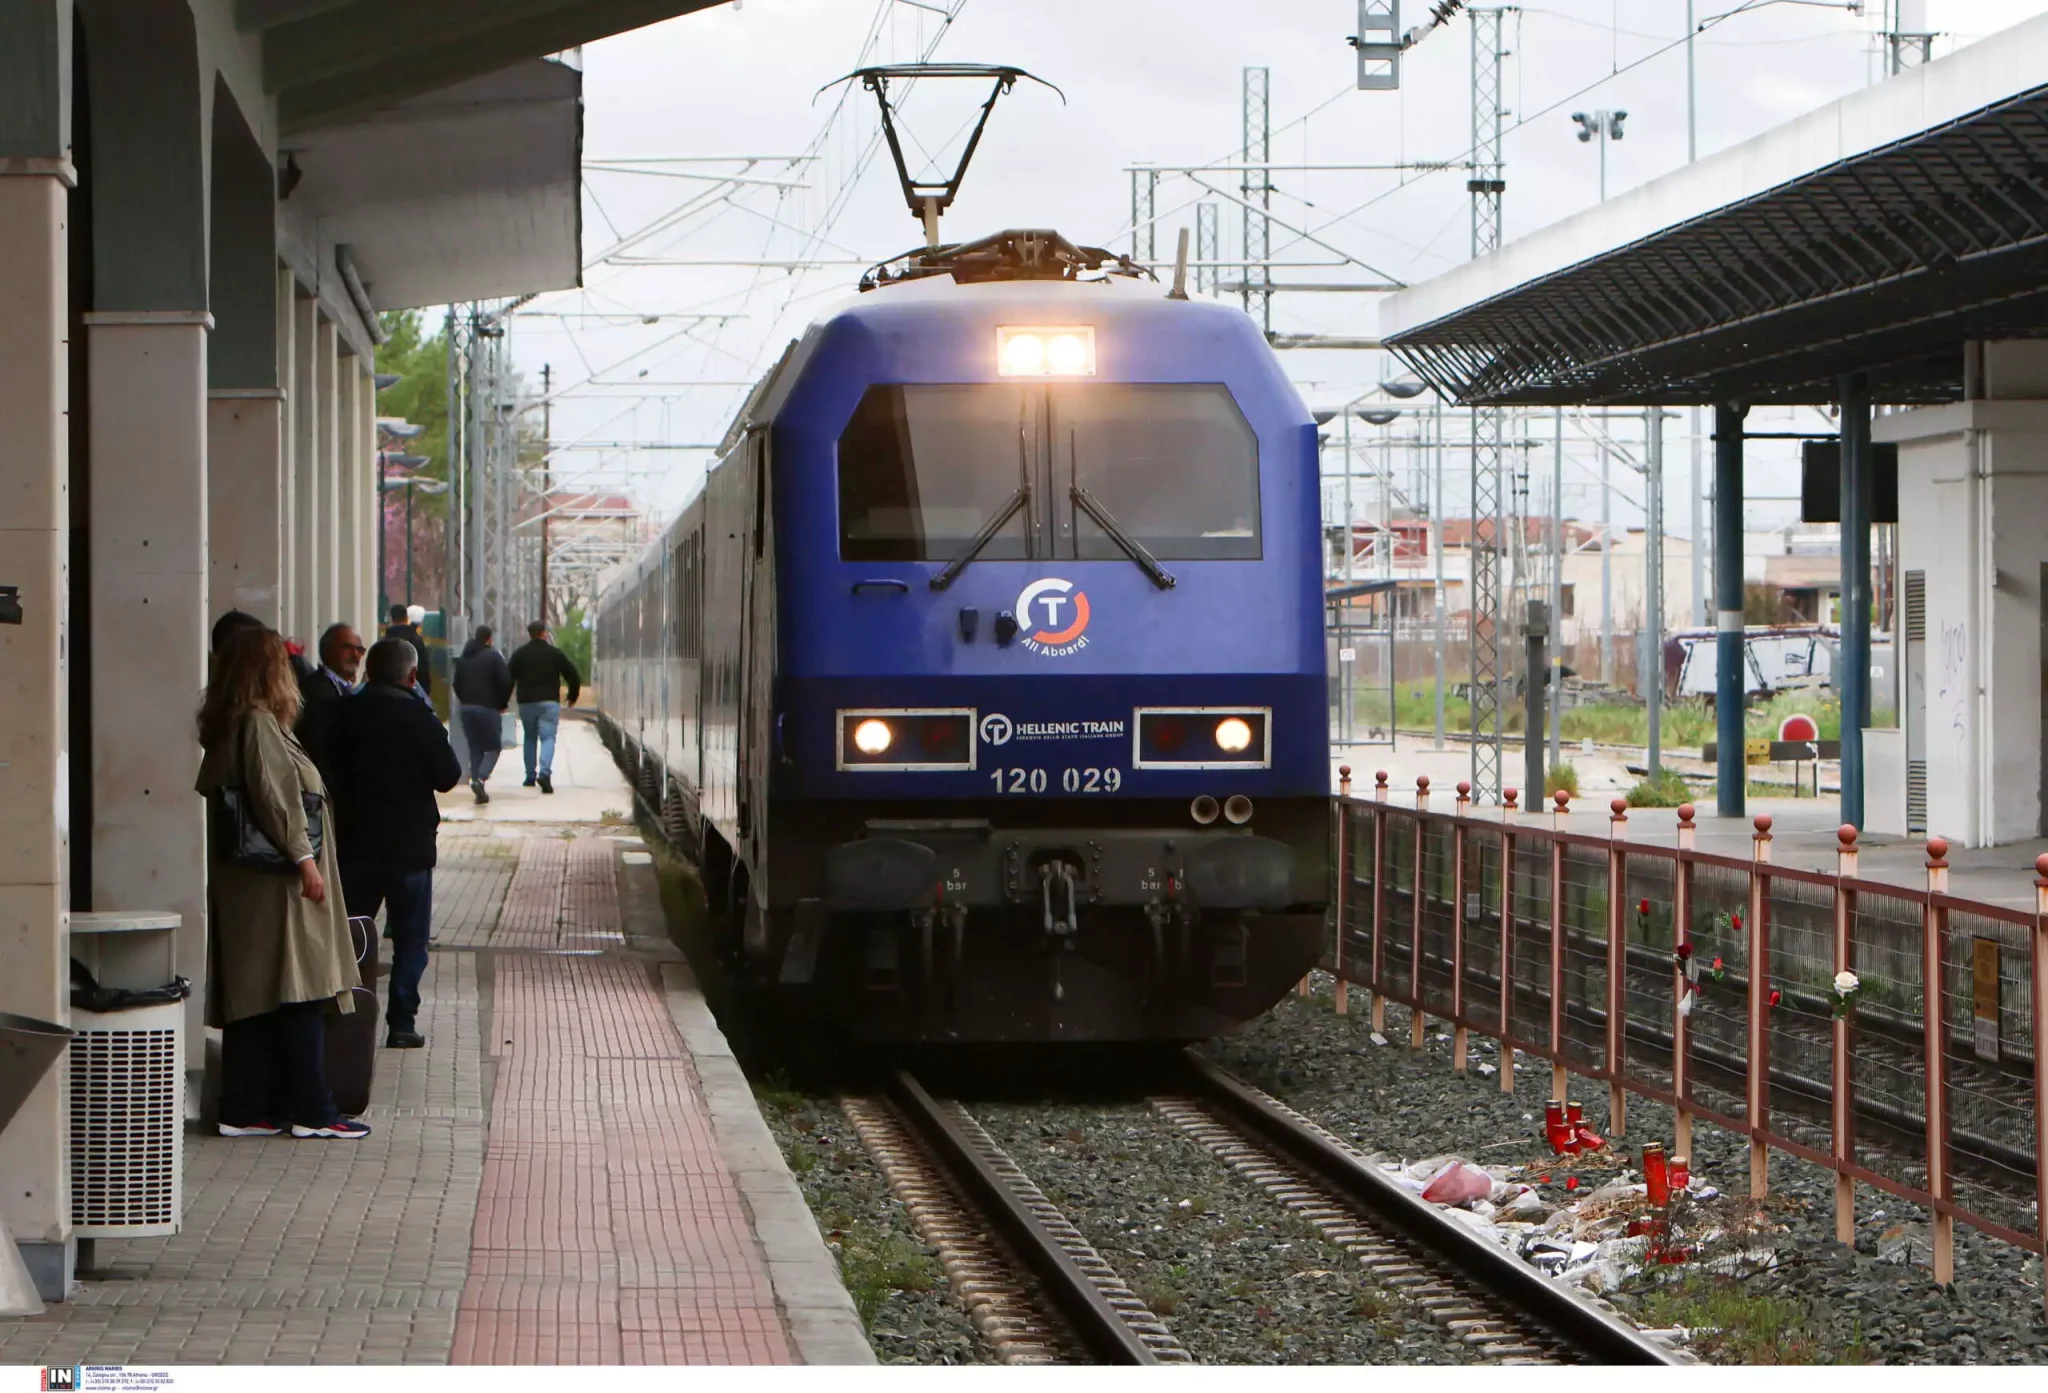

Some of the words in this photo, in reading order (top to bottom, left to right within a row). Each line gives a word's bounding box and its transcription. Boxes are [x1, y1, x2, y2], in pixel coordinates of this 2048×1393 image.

[1021, 637, 1039, 652] All
[1041, 635, 1090, 657] Aboard!
[1016, 722, 1079, 735] HELLENIC
[1082, 721, 1124, 733] TRAIN
[990, 767, 1048, 794] 120
[1062, 767, 1121, 793] 029
[952, 868, 960, 878] 5
[1147, 867, 1155, 878] 5
[947, 880, 968, 891] bar
[1141, 879, 1161, 890] bar
